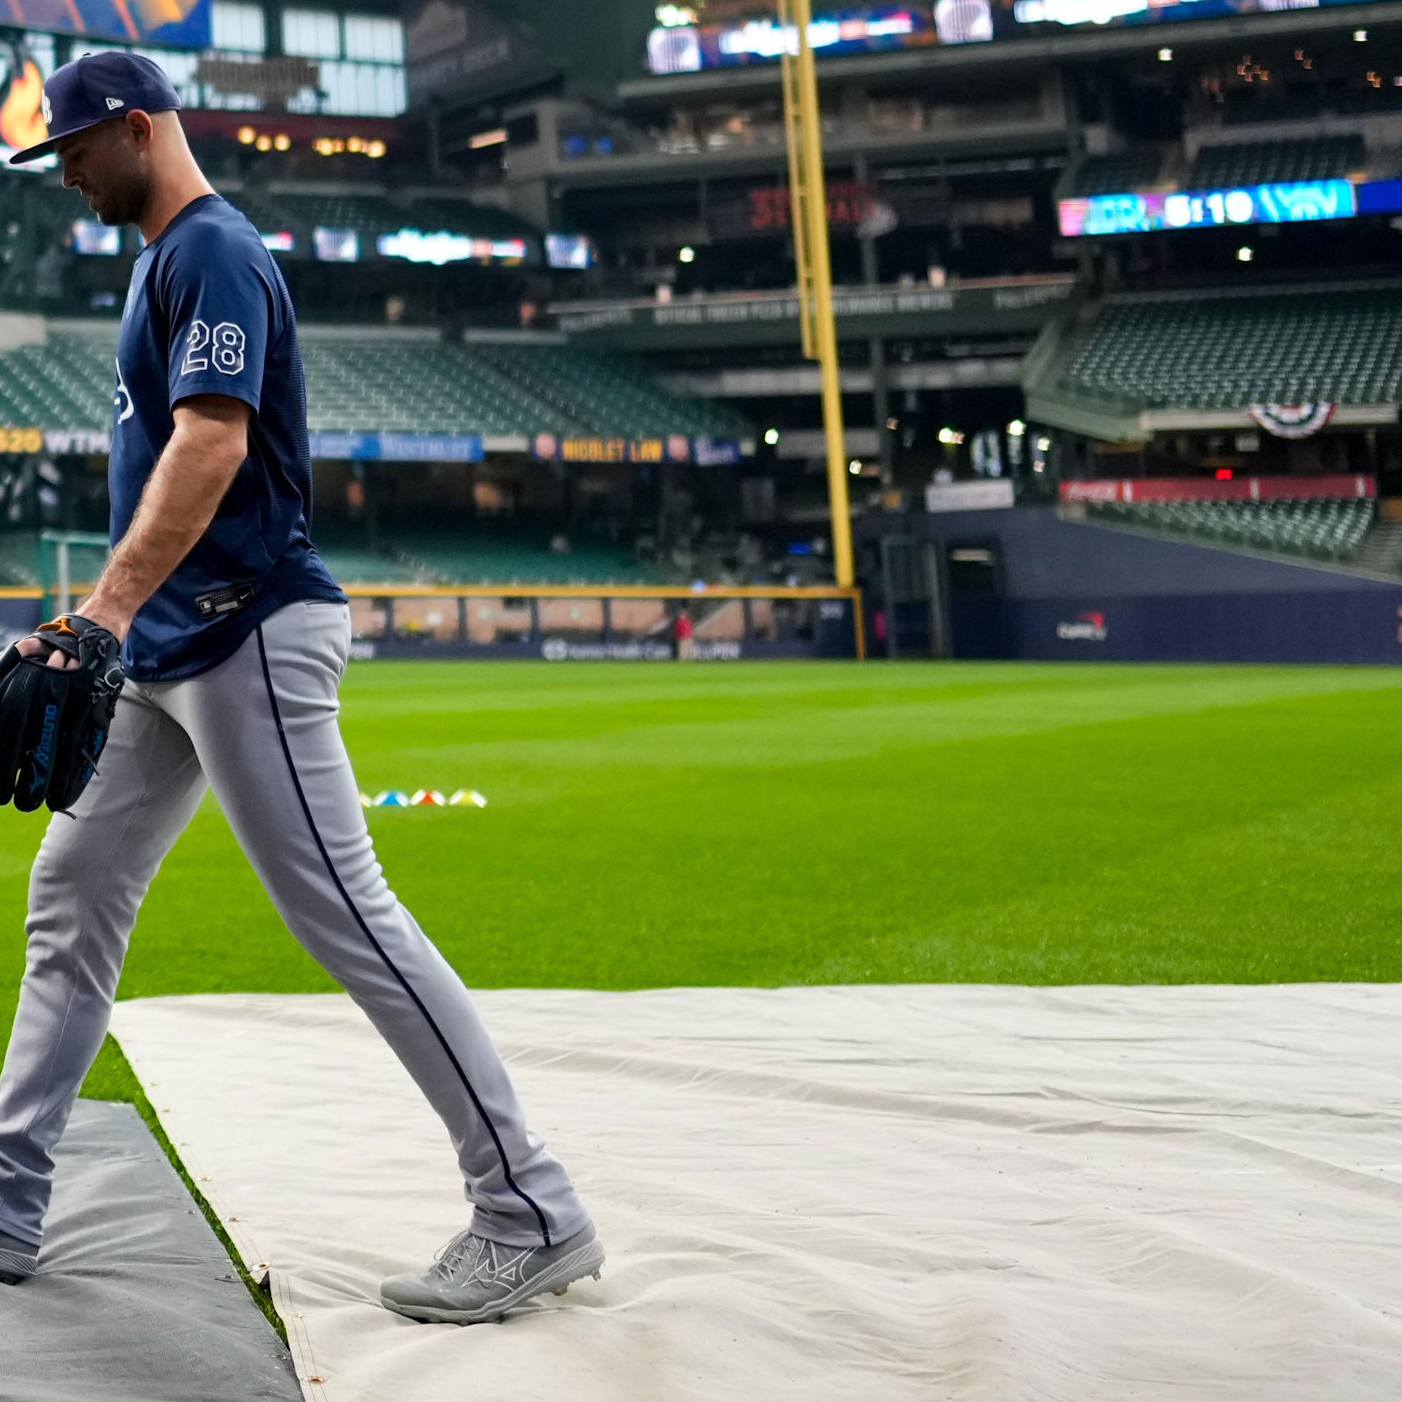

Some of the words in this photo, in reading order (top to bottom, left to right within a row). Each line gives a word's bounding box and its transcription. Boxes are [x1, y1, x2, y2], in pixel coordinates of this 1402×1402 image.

[180, 320, 246, 376] 28
[44, 429, 110, 455] WTM
[561, 438, 625, 461] NICOLET
[630, 438, 663, 460] LAW
